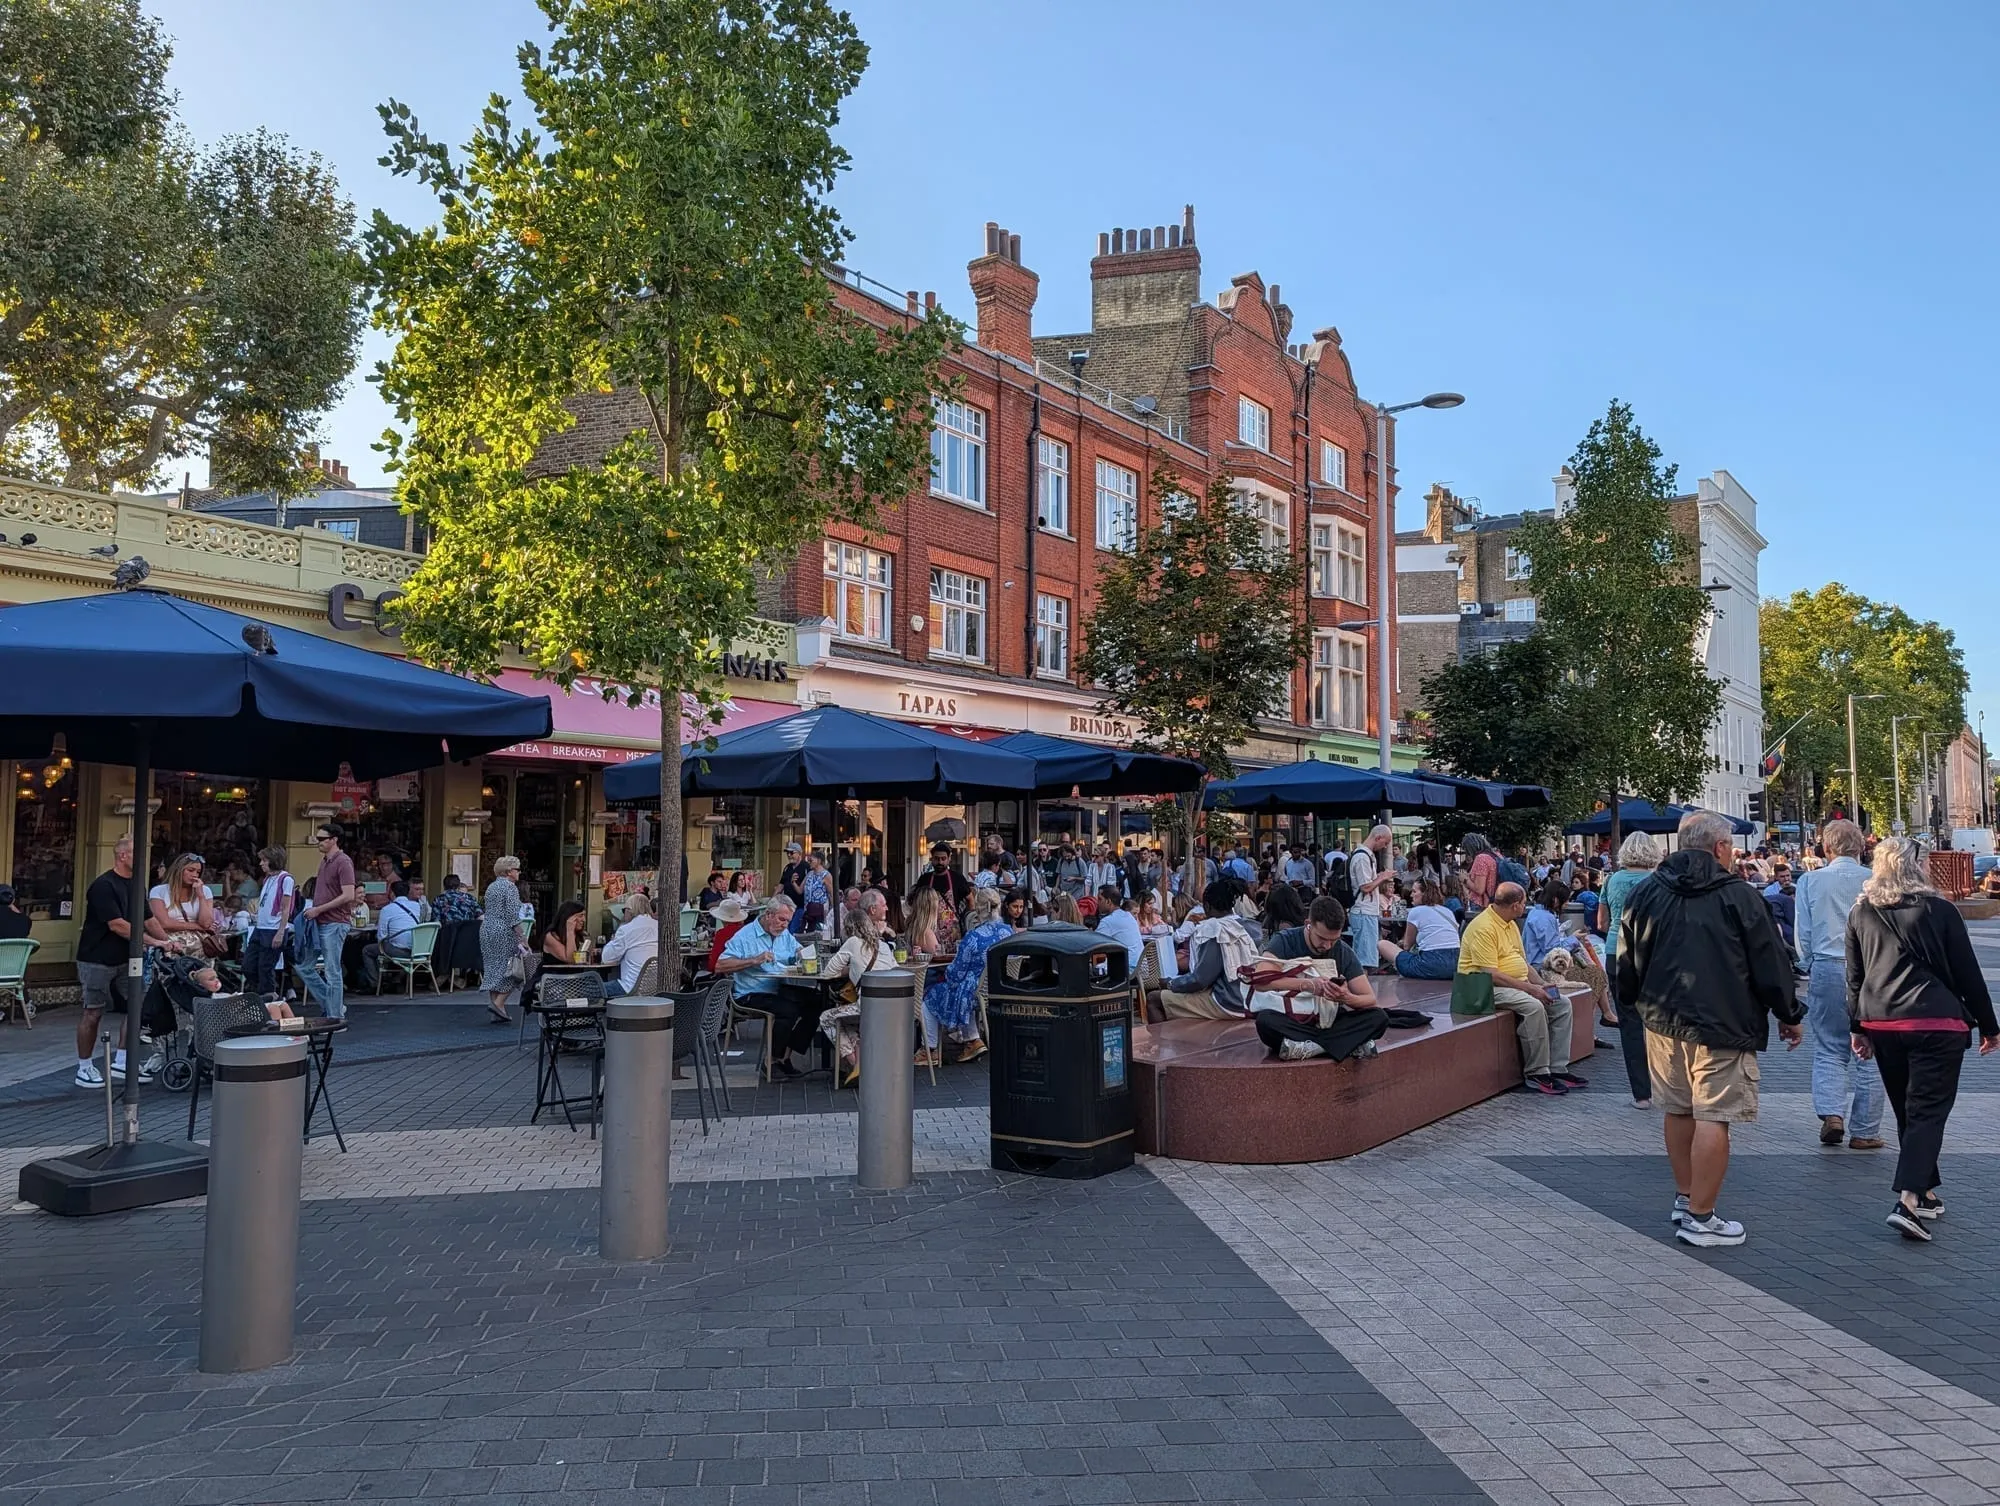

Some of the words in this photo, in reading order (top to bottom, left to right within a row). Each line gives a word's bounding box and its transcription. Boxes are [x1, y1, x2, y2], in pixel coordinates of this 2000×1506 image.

[898, 692, 957, 717] TAPAS
[1069, 715, 1133, 739] BRINDISA
[519, 743, 540, 754] TEA
[552, 745, 609, 759] BREAKFAST
